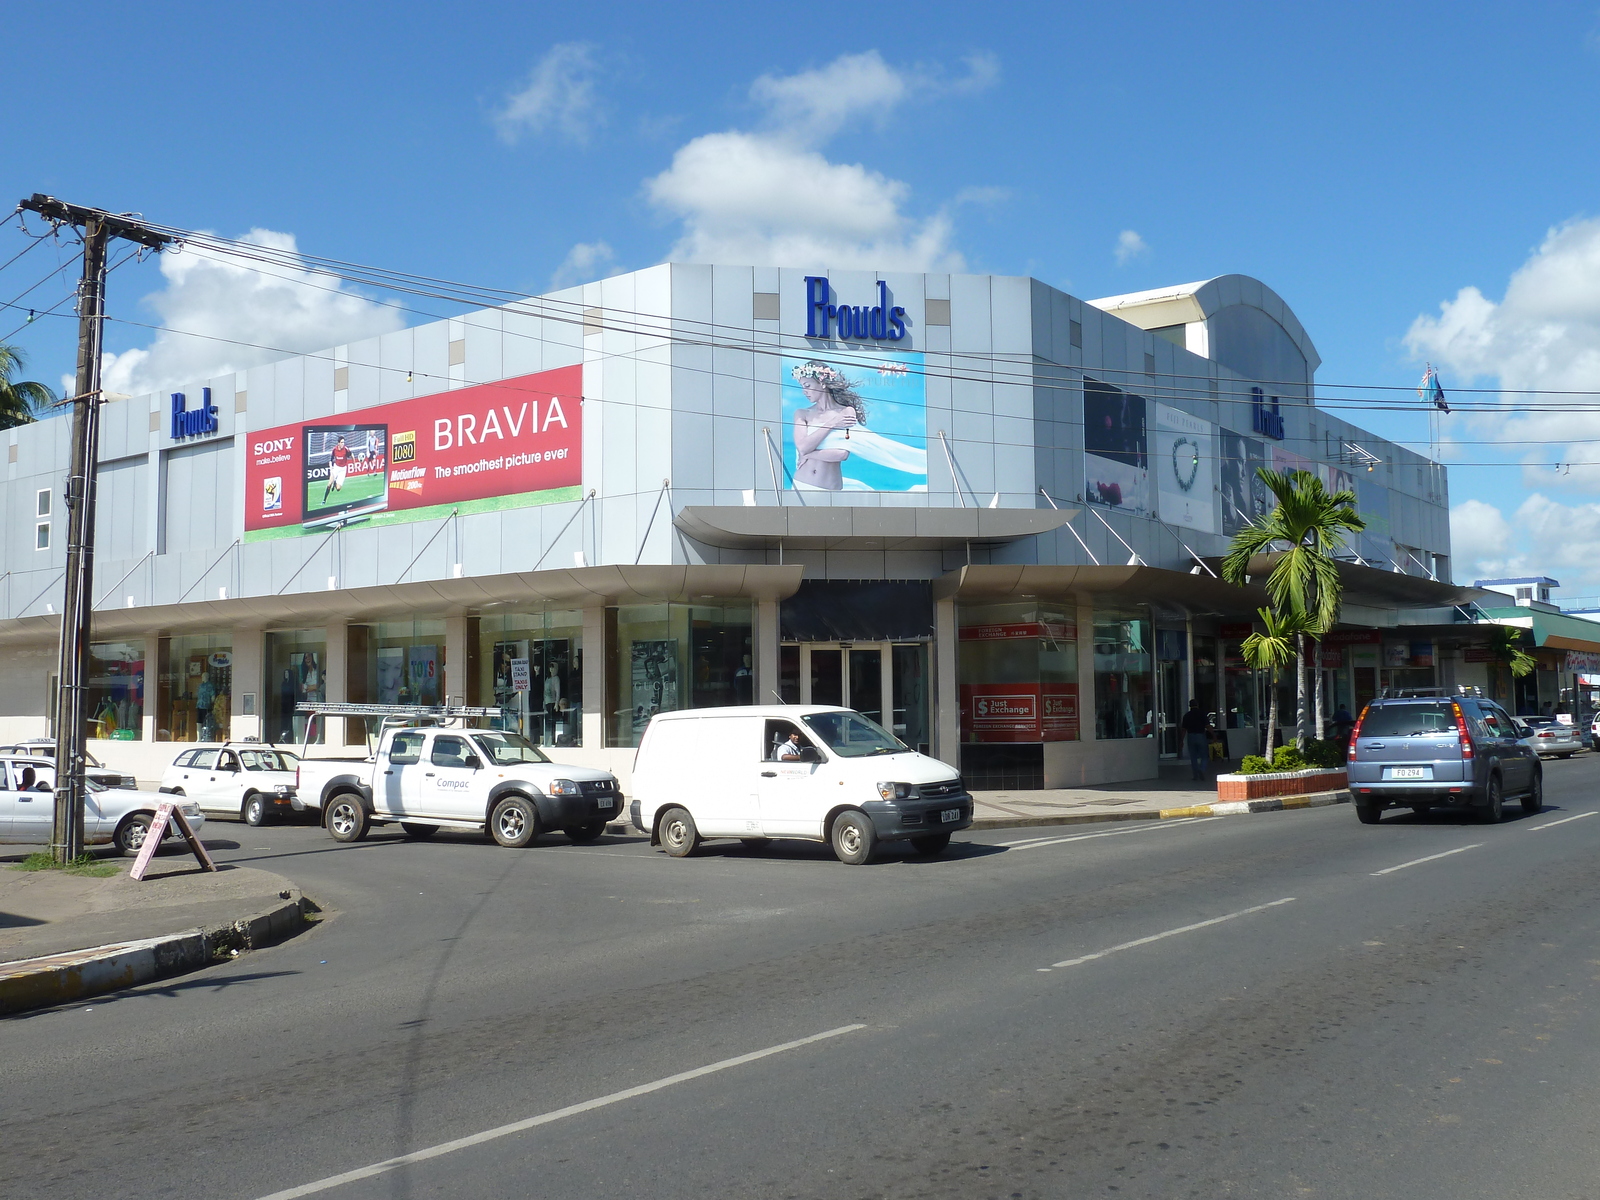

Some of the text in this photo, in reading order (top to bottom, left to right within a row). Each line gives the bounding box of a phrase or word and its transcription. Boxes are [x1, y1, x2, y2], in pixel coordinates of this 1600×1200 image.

[804, 276, 905, 341] Prouds
[170, 387, 219, 439] Prouds
[434, 396, 569, 451] BRAVIA
[405, 433, 414, 441] HD
[254, 437, 295, 456] SONY
[394, 443, 414, 461] 1080
[434, 448, 569, 479] The smoothest picture ever
[1328, 632, 1371, 641] vodafone
[411, 660, 434, 678] TOYS
[634, 681, 676, 691] GUCCI
[990, 706, 1029, 714] Exchange
[1407, 768, 1420, 776] 294
[436, 777, 470, 790] Compac
